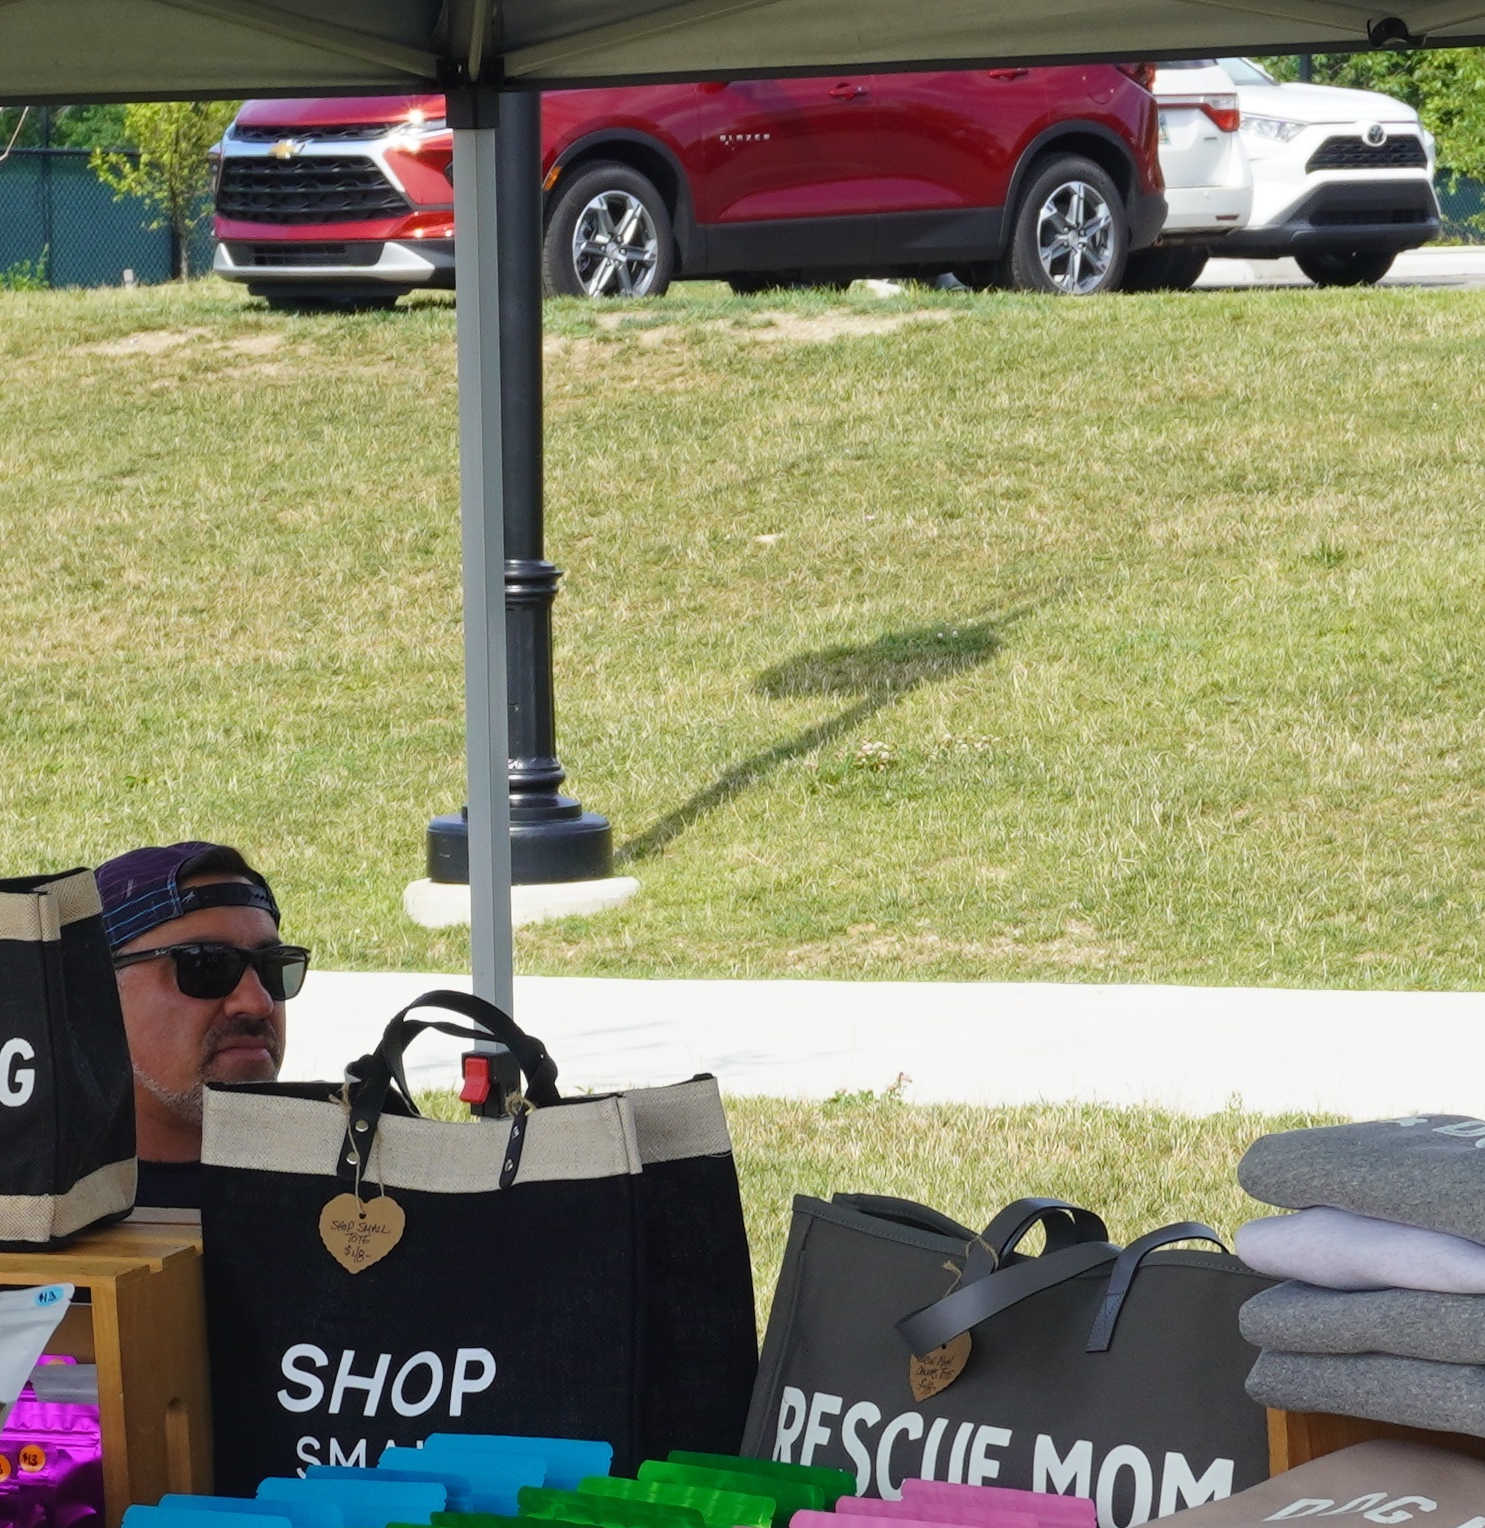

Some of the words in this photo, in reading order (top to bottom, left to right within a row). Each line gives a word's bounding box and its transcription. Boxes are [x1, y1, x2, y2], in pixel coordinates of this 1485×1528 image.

[276, 1342, 497, 1418] SHOP
[296, 1435, 424, 1480] SM
[772, 1385, 1013, 1501] RESCUE
[1261, 1491, 1438, 1525] DOG
